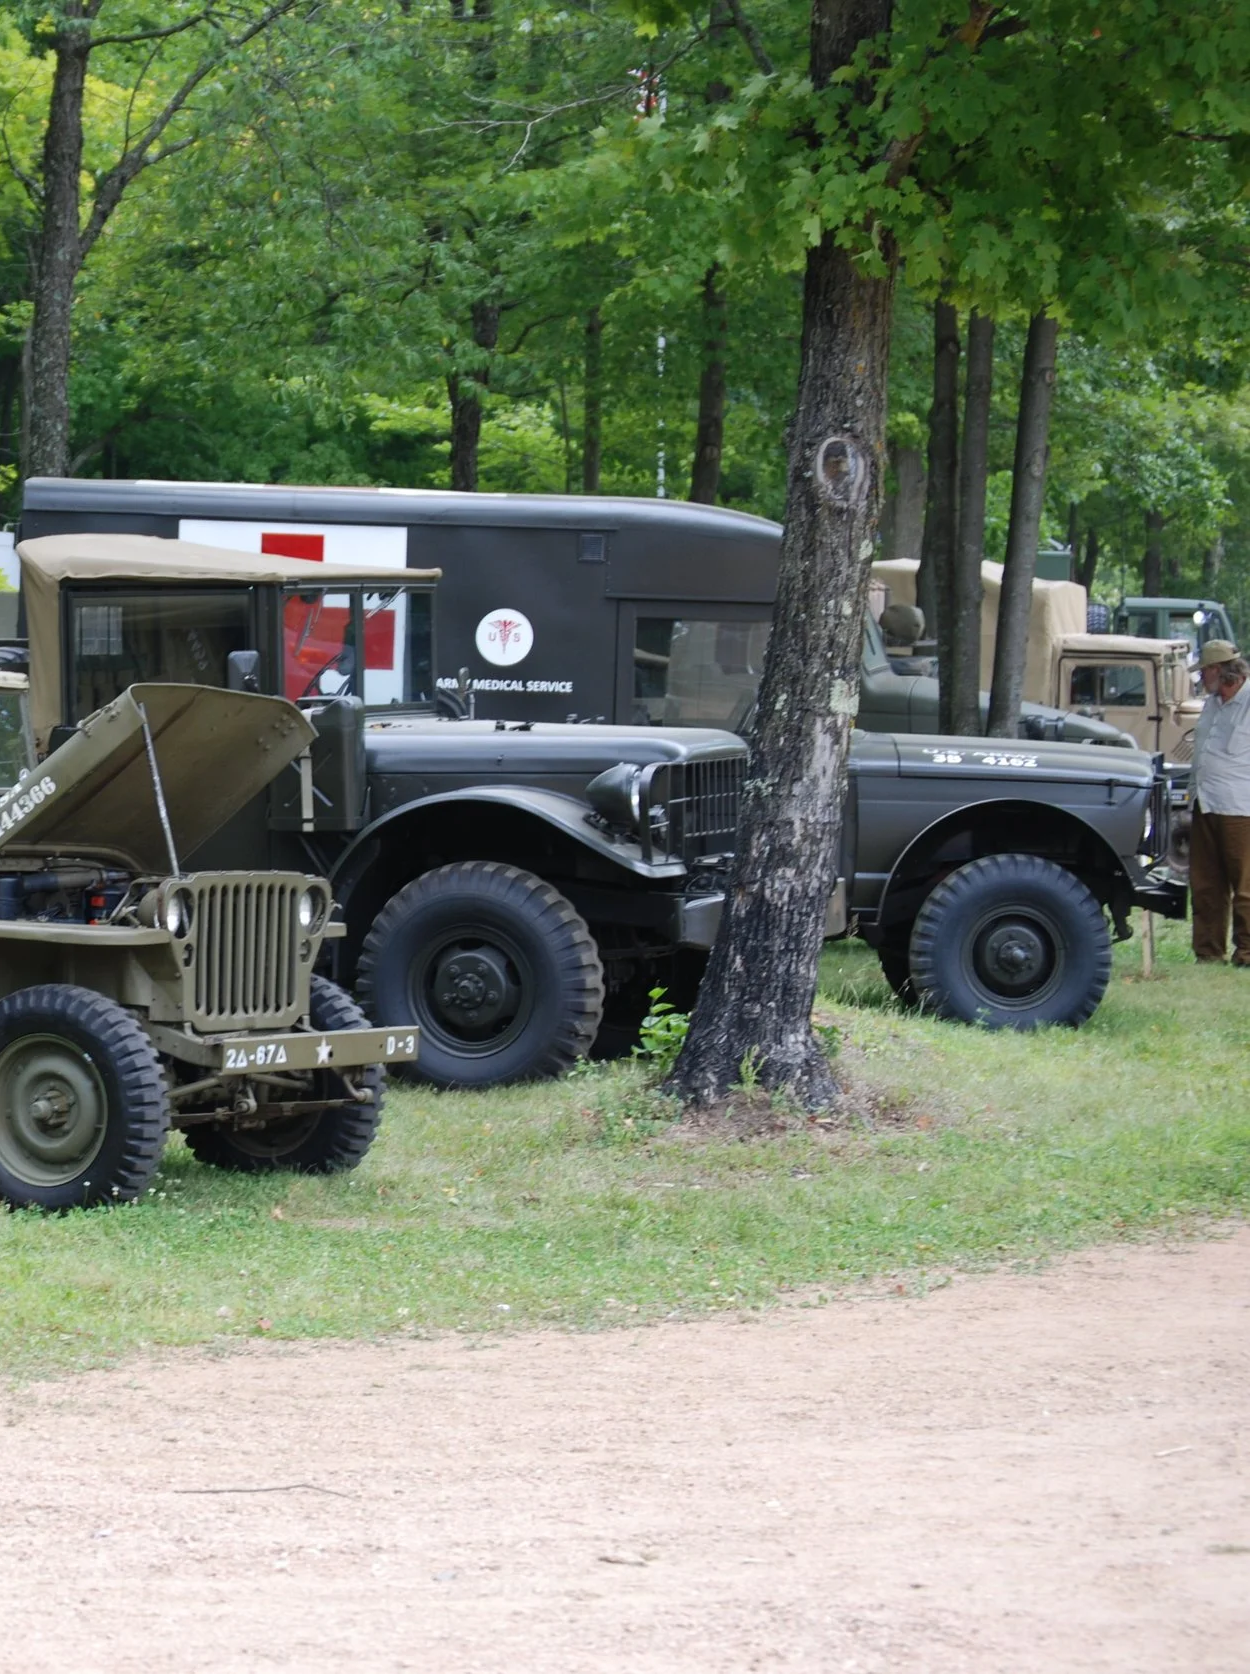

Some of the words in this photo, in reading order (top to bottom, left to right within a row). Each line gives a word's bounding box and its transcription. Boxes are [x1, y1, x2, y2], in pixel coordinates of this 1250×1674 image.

[488, 632, 497, 641] U
[513, 633, 521, 642] S
[474, 678, 524, 691] MEDICAL
[526, 681, 573, 692] SERVICE
